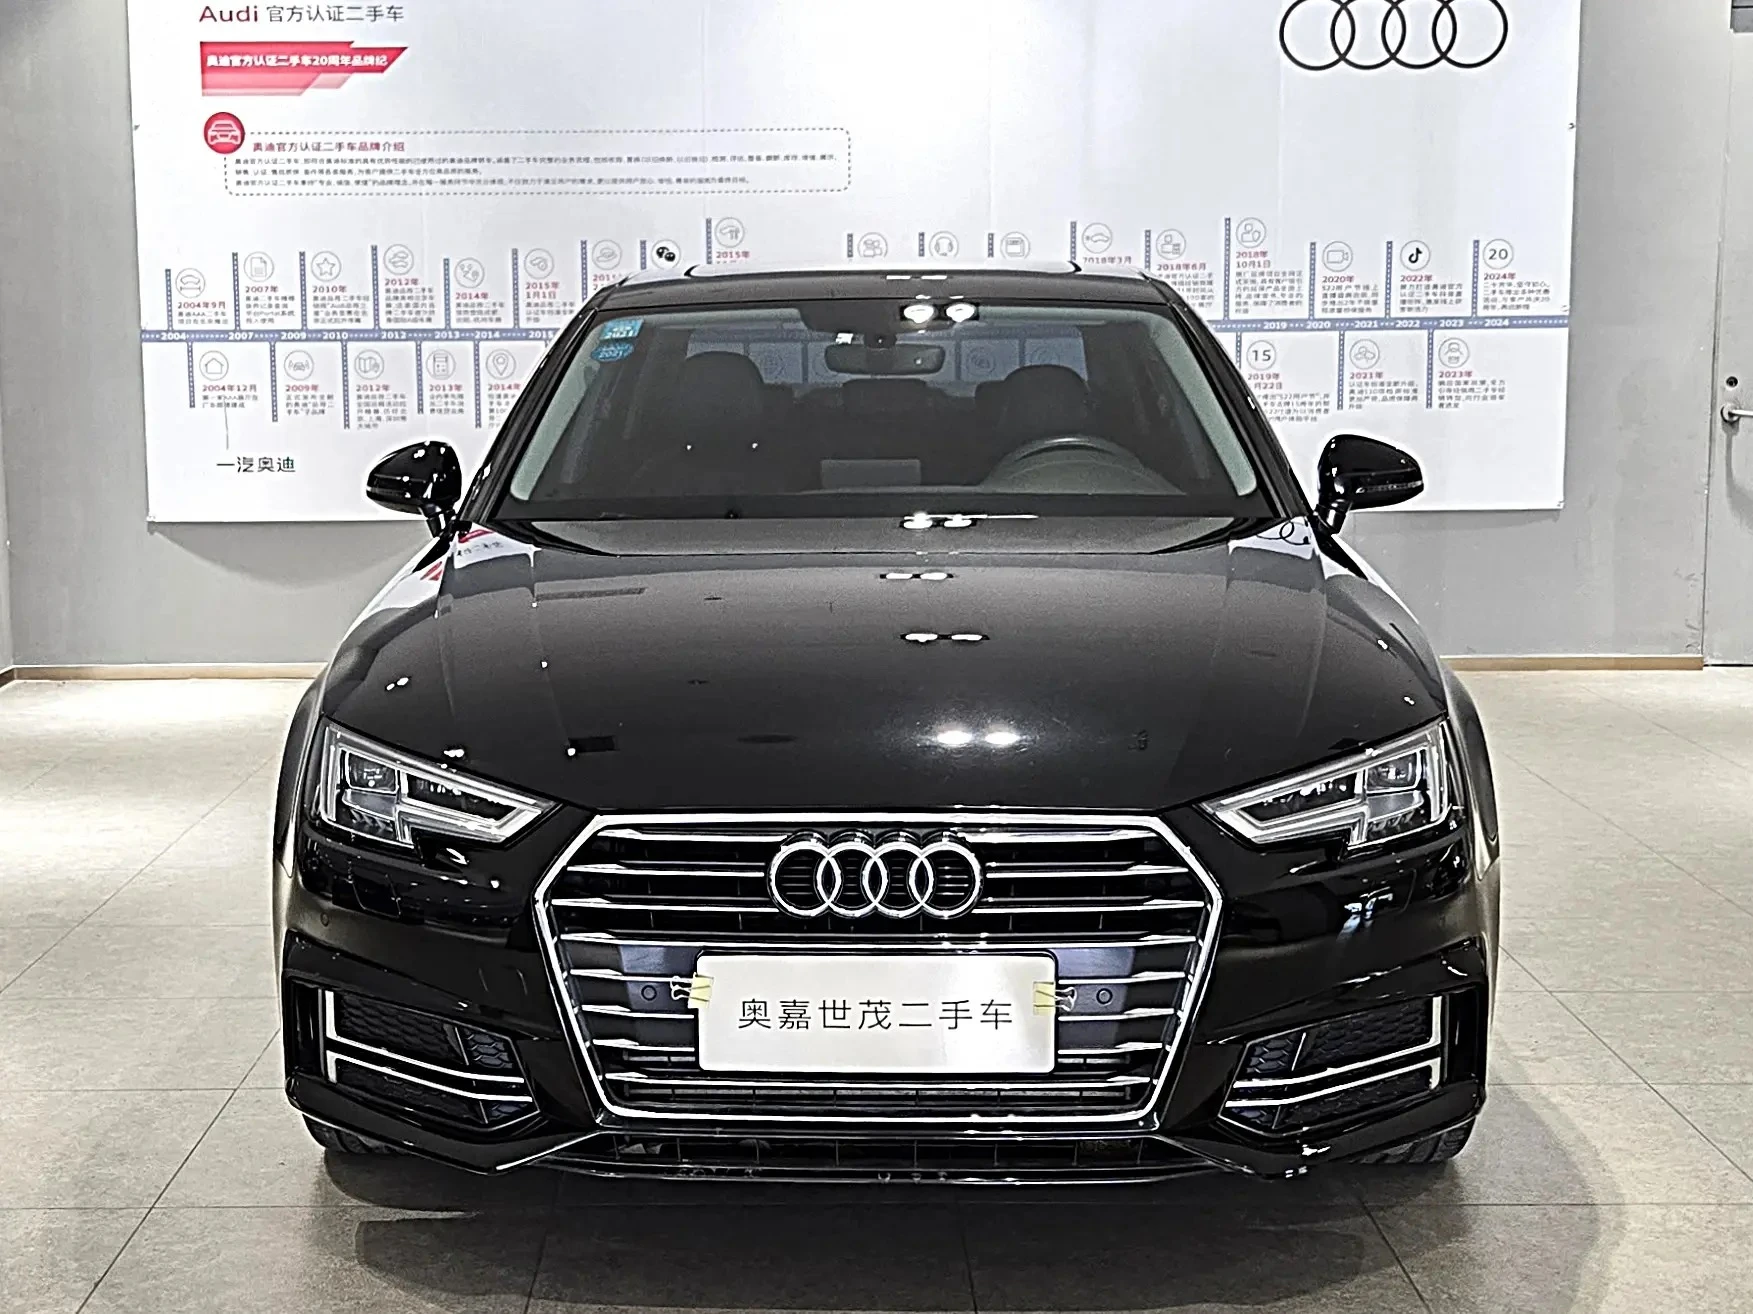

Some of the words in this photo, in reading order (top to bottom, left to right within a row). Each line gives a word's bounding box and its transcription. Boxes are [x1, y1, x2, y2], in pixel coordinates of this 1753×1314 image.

[199, 6, 257, 22] Audi
[267, 5, 403, 22] 官方认证二手车
[252, 141, 405, 153] 奥迪官方认证二手车品牌介绍
[715, 250, 750, 259] 2015年
[1235, 250, 1269, 259] 2018年
[1488, 248, 1509, 261] 20
[1156, 262, 1207, 271] 2018年6月
[1322, 275, 1355, 284] 2020年
[1400, 274, 1433, 283] 2022年
[1483, 272, 1516, 281] 2024年
[384, 278, 419, 286] 2012年
[525, 281, 560, 290] 2015年
[245, 285, 279, 294] 2007年
[312, 285, 347, 294] 2010年
[455, 292, 489, 300] 2014年
[177, 301, 226, 310] 2004年9月
[1263, 321, 1288, 330] 2019
[1305, 320, 1332, 330] 2020
[1354, 319, 1379, 329] 2021
[1395, 319, 1421, 328] 2022
[1439, 318, 1465, 328] 2023
[1484, 318, 1510, 327] 2024
[160, 331, 188, 341] 2004
[228, 331, 254, 341] 2007
[280, 331, 307, 340] 2009
[322, 331, 349, 340] 2010
[381, 330, 407, 340] 2012
[434, 330, 461, 340] 2013
[474, 330, 501, 339] 2014
[528, 330, 555, 340] 2015
[1252, 349, 1272, 362] 15
[1247, 372, 1280, 381] 2019年
[1349, 371, 1384, 380] 2021年
[1438, 370, 1473, 379] 2023年
[202, 384, 257, 393] 2004年12月
[285, 384, 319, 393] 2009年
[355, 383, 390, 393] 2012年
[429, 383, 463, 392] 2013年
[487, 383, 521, 391] 2014年
[217, 457, 295, 472] 一汽奥迪
[739, 999, 1012, 1029] 奥嘉世茂二手车
